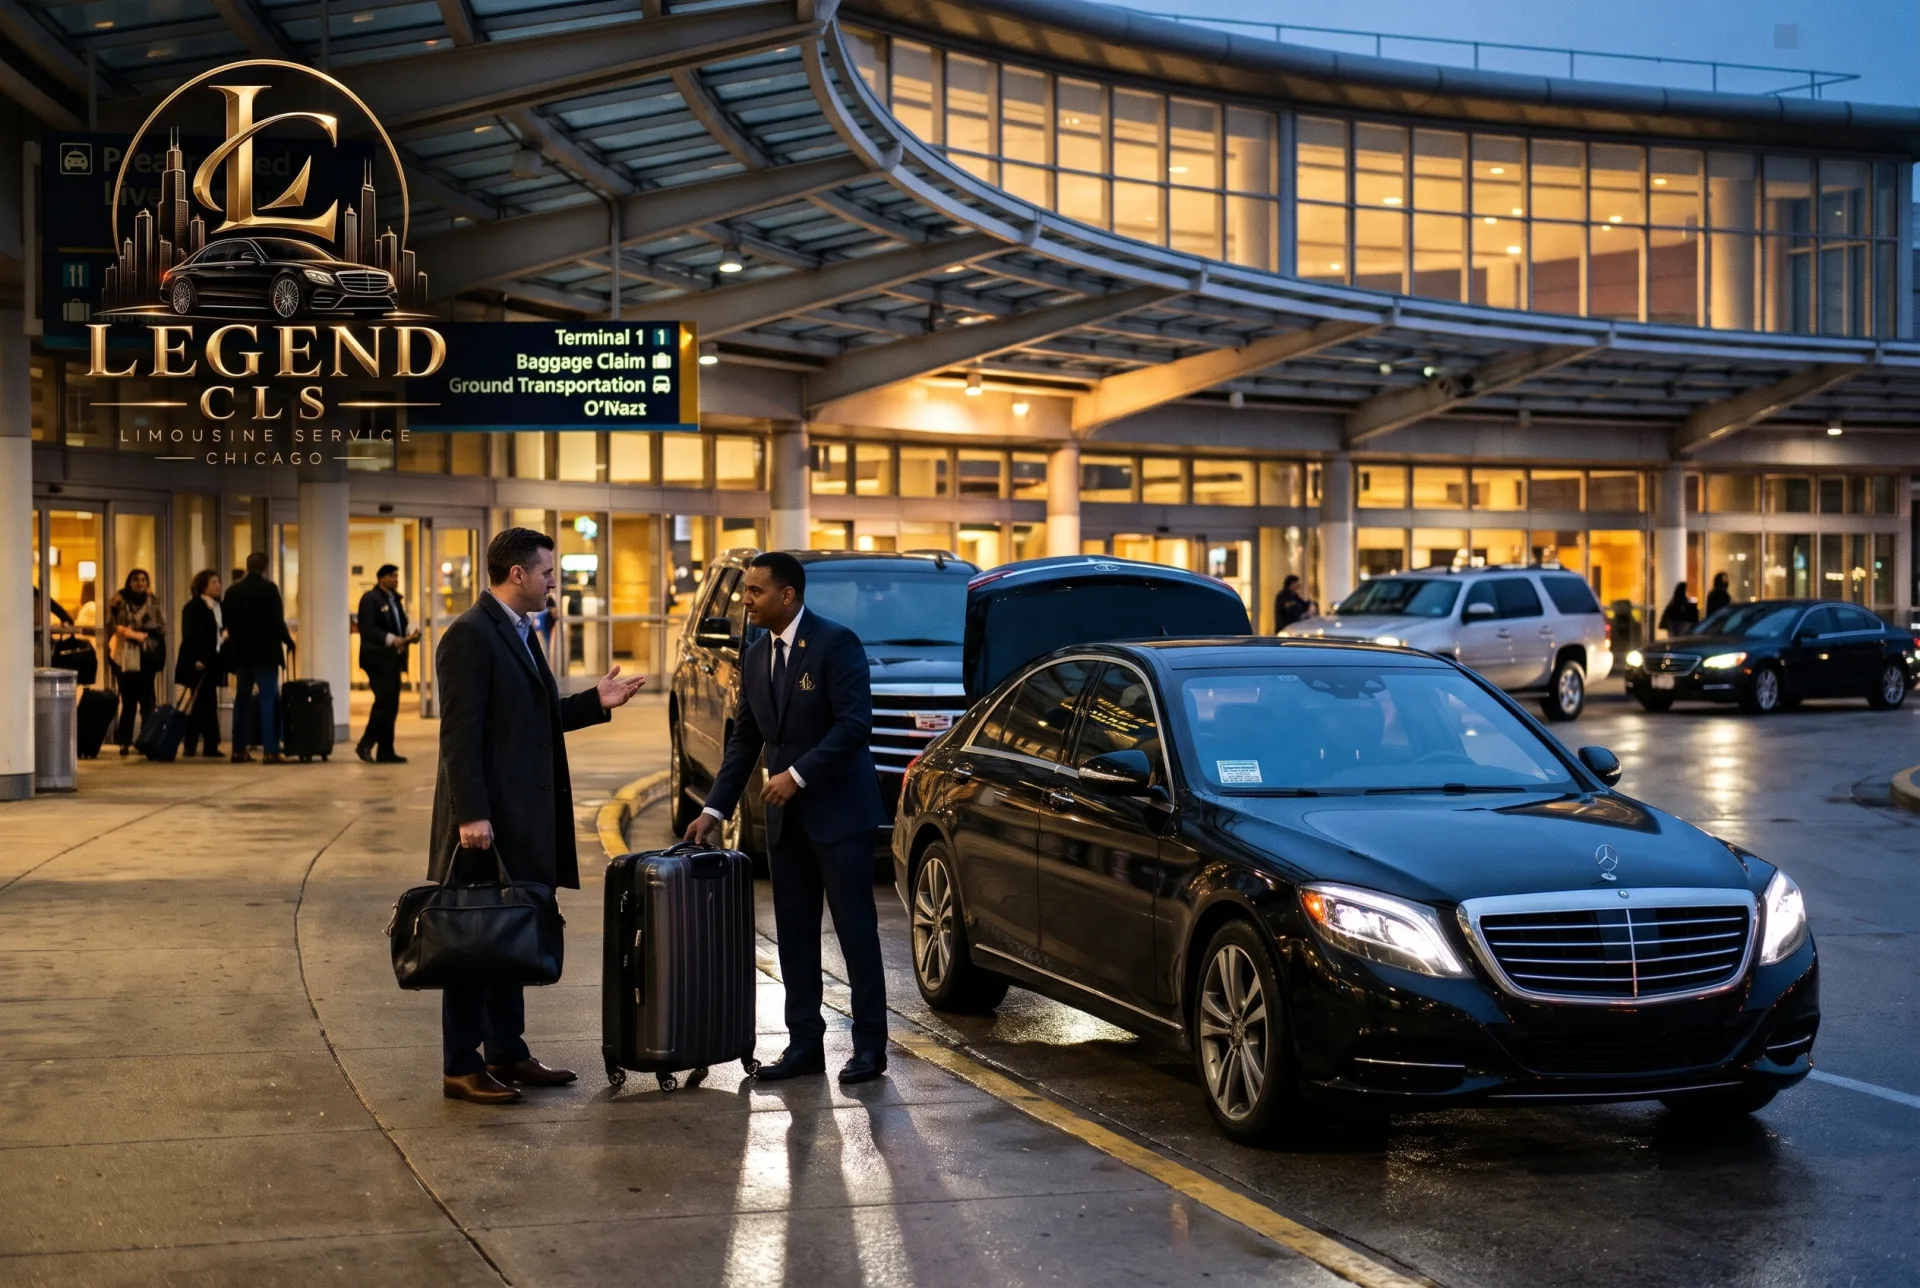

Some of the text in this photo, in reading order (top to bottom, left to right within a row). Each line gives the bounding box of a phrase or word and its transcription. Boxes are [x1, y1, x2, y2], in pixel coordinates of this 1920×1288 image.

[555, 328, 631, 346] Terminal
[635, 329, 644, 345] 1
[516, 352, 646, 374] Baggage Claim
[449, 376, 646, 397] Ground Transportation
